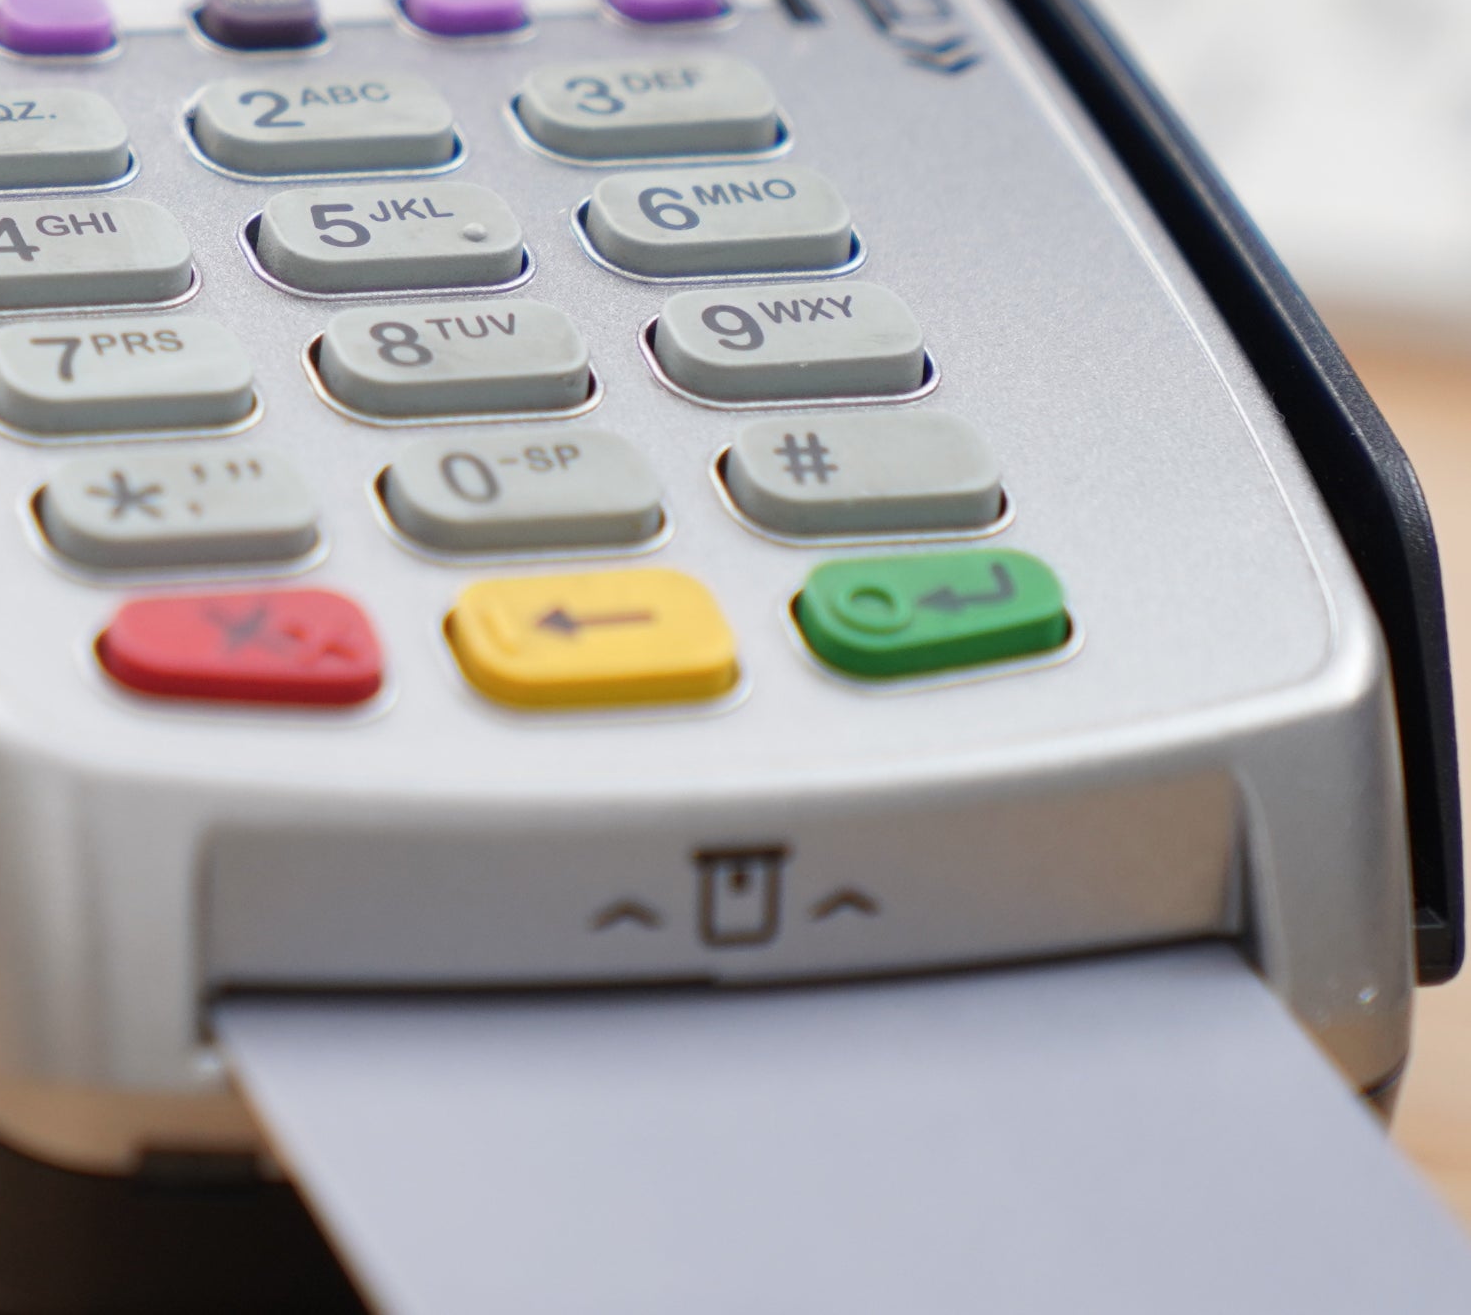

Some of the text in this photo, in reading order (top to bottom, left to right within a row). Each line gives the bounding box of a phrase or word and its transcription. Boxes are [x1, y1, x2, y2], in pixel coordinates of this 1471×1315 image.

[238, 84, 389, 128] 2 ABC
[565, 67, 703, 115] 3 DEF
[36, 212, 117, 236] GHI
[310, 198, 454, 247] 5 JKL
[638, 179, 796, 230] 6 MNO
[369, 313, 515, 367] 8 TUV
[702, 295, 854, 351] 9 WXY
[31, 330, 183, 382] 7 PRS
